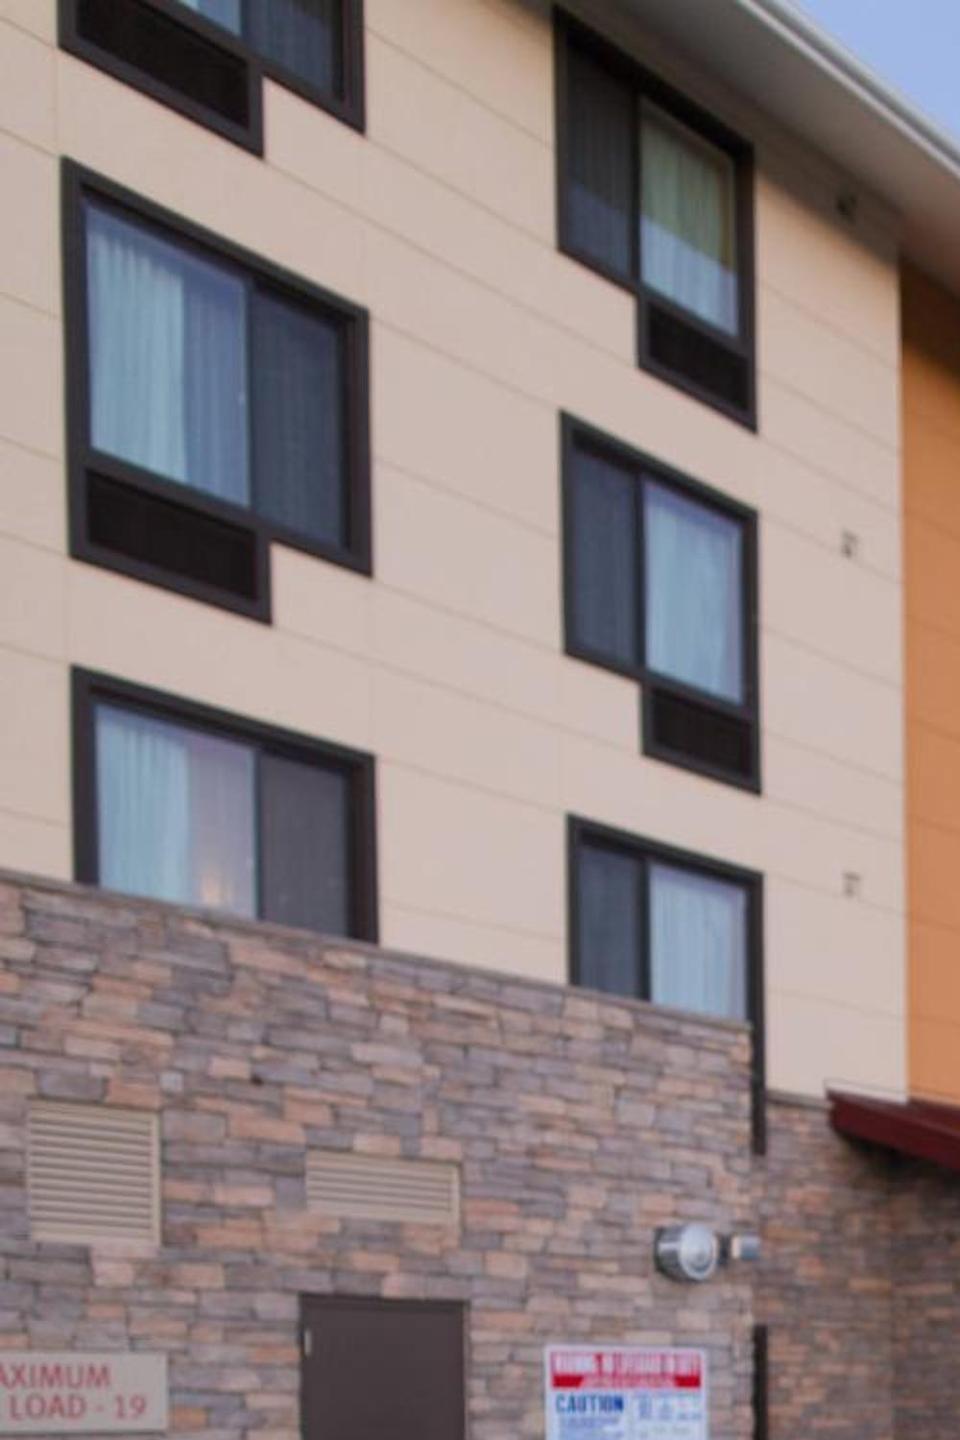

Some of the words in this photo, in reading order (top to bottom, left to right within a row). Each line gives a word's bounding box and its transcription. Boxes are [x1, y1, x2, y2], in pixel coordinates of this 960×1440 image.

[0, 1362, 111, 1390] AXIMUM
[9, 1393, 86, 1420] LOAD
[114, 1394, 148, 1419] 19
[556, 1394, 625, 1414] CAUTION
